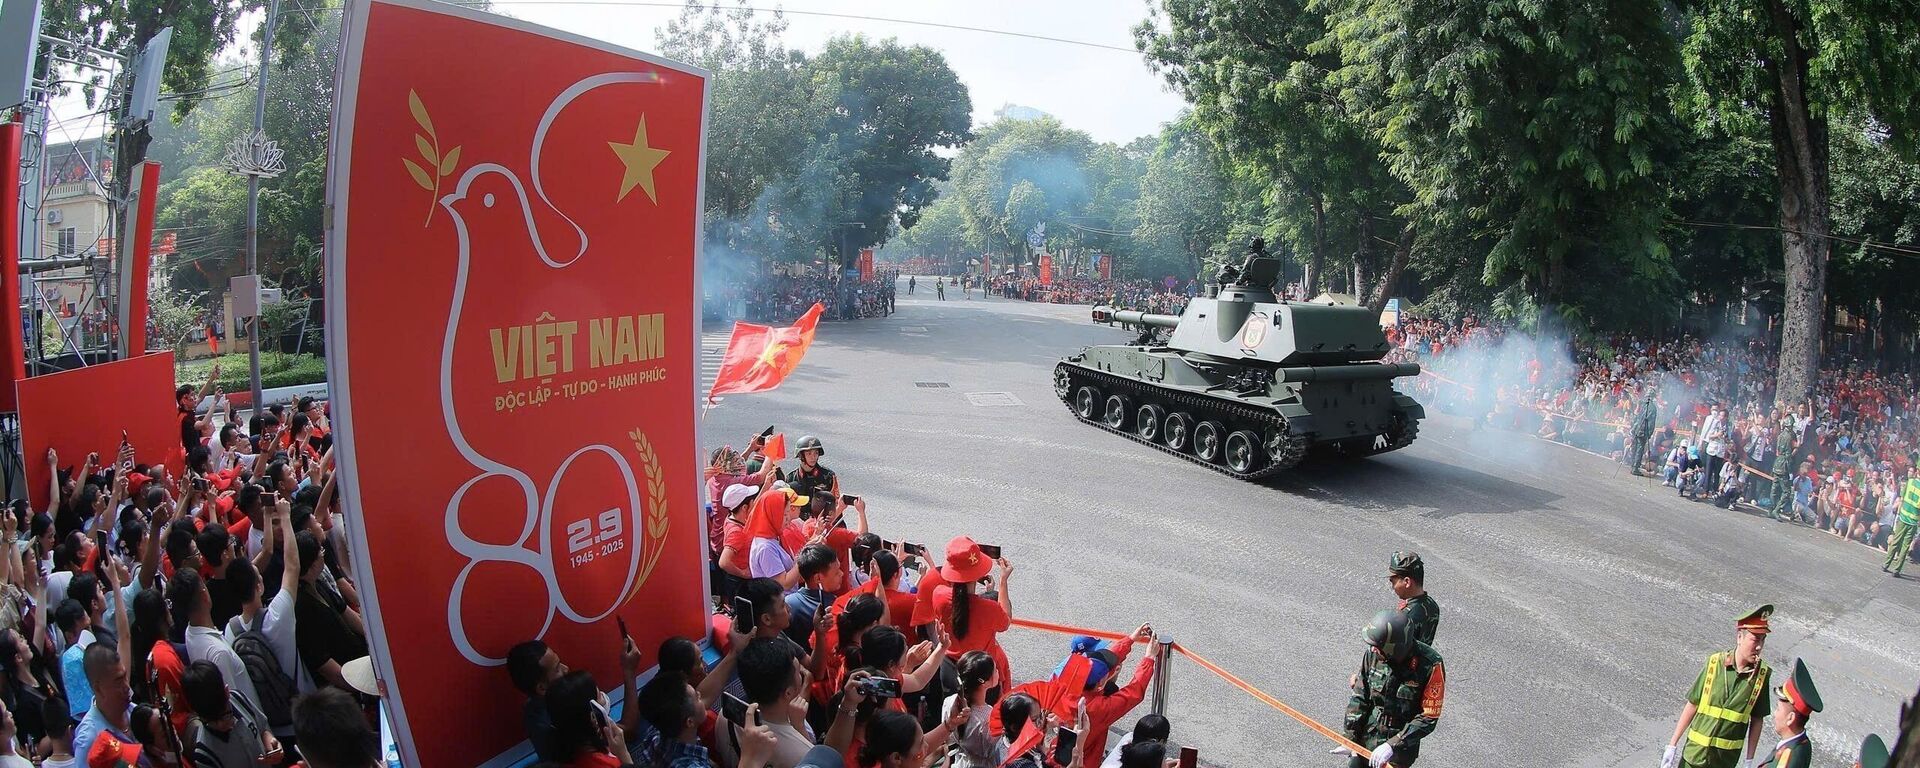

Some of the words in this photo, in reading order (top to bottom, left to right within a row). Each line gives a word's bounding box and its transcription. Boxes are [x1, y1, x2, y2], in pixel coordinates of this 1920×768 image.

[490, 312, 578, 384] VIỆT
[589, 313, 665, 369] NAM
[495, 391, 525, 412] ĐỘC
[529, 386, 551, 407] LẬP
[563, 381, 579, 400] TỰ
[580, 380, 598, 395] DO
[608, 372, 638, 391] HẠNH
[640, 366, 666, 384] PHÚC
[567, 507, 623, 554] 2.9
[570, 550, 594, 568] 1945
[601, 538, 624, 557] 2025
